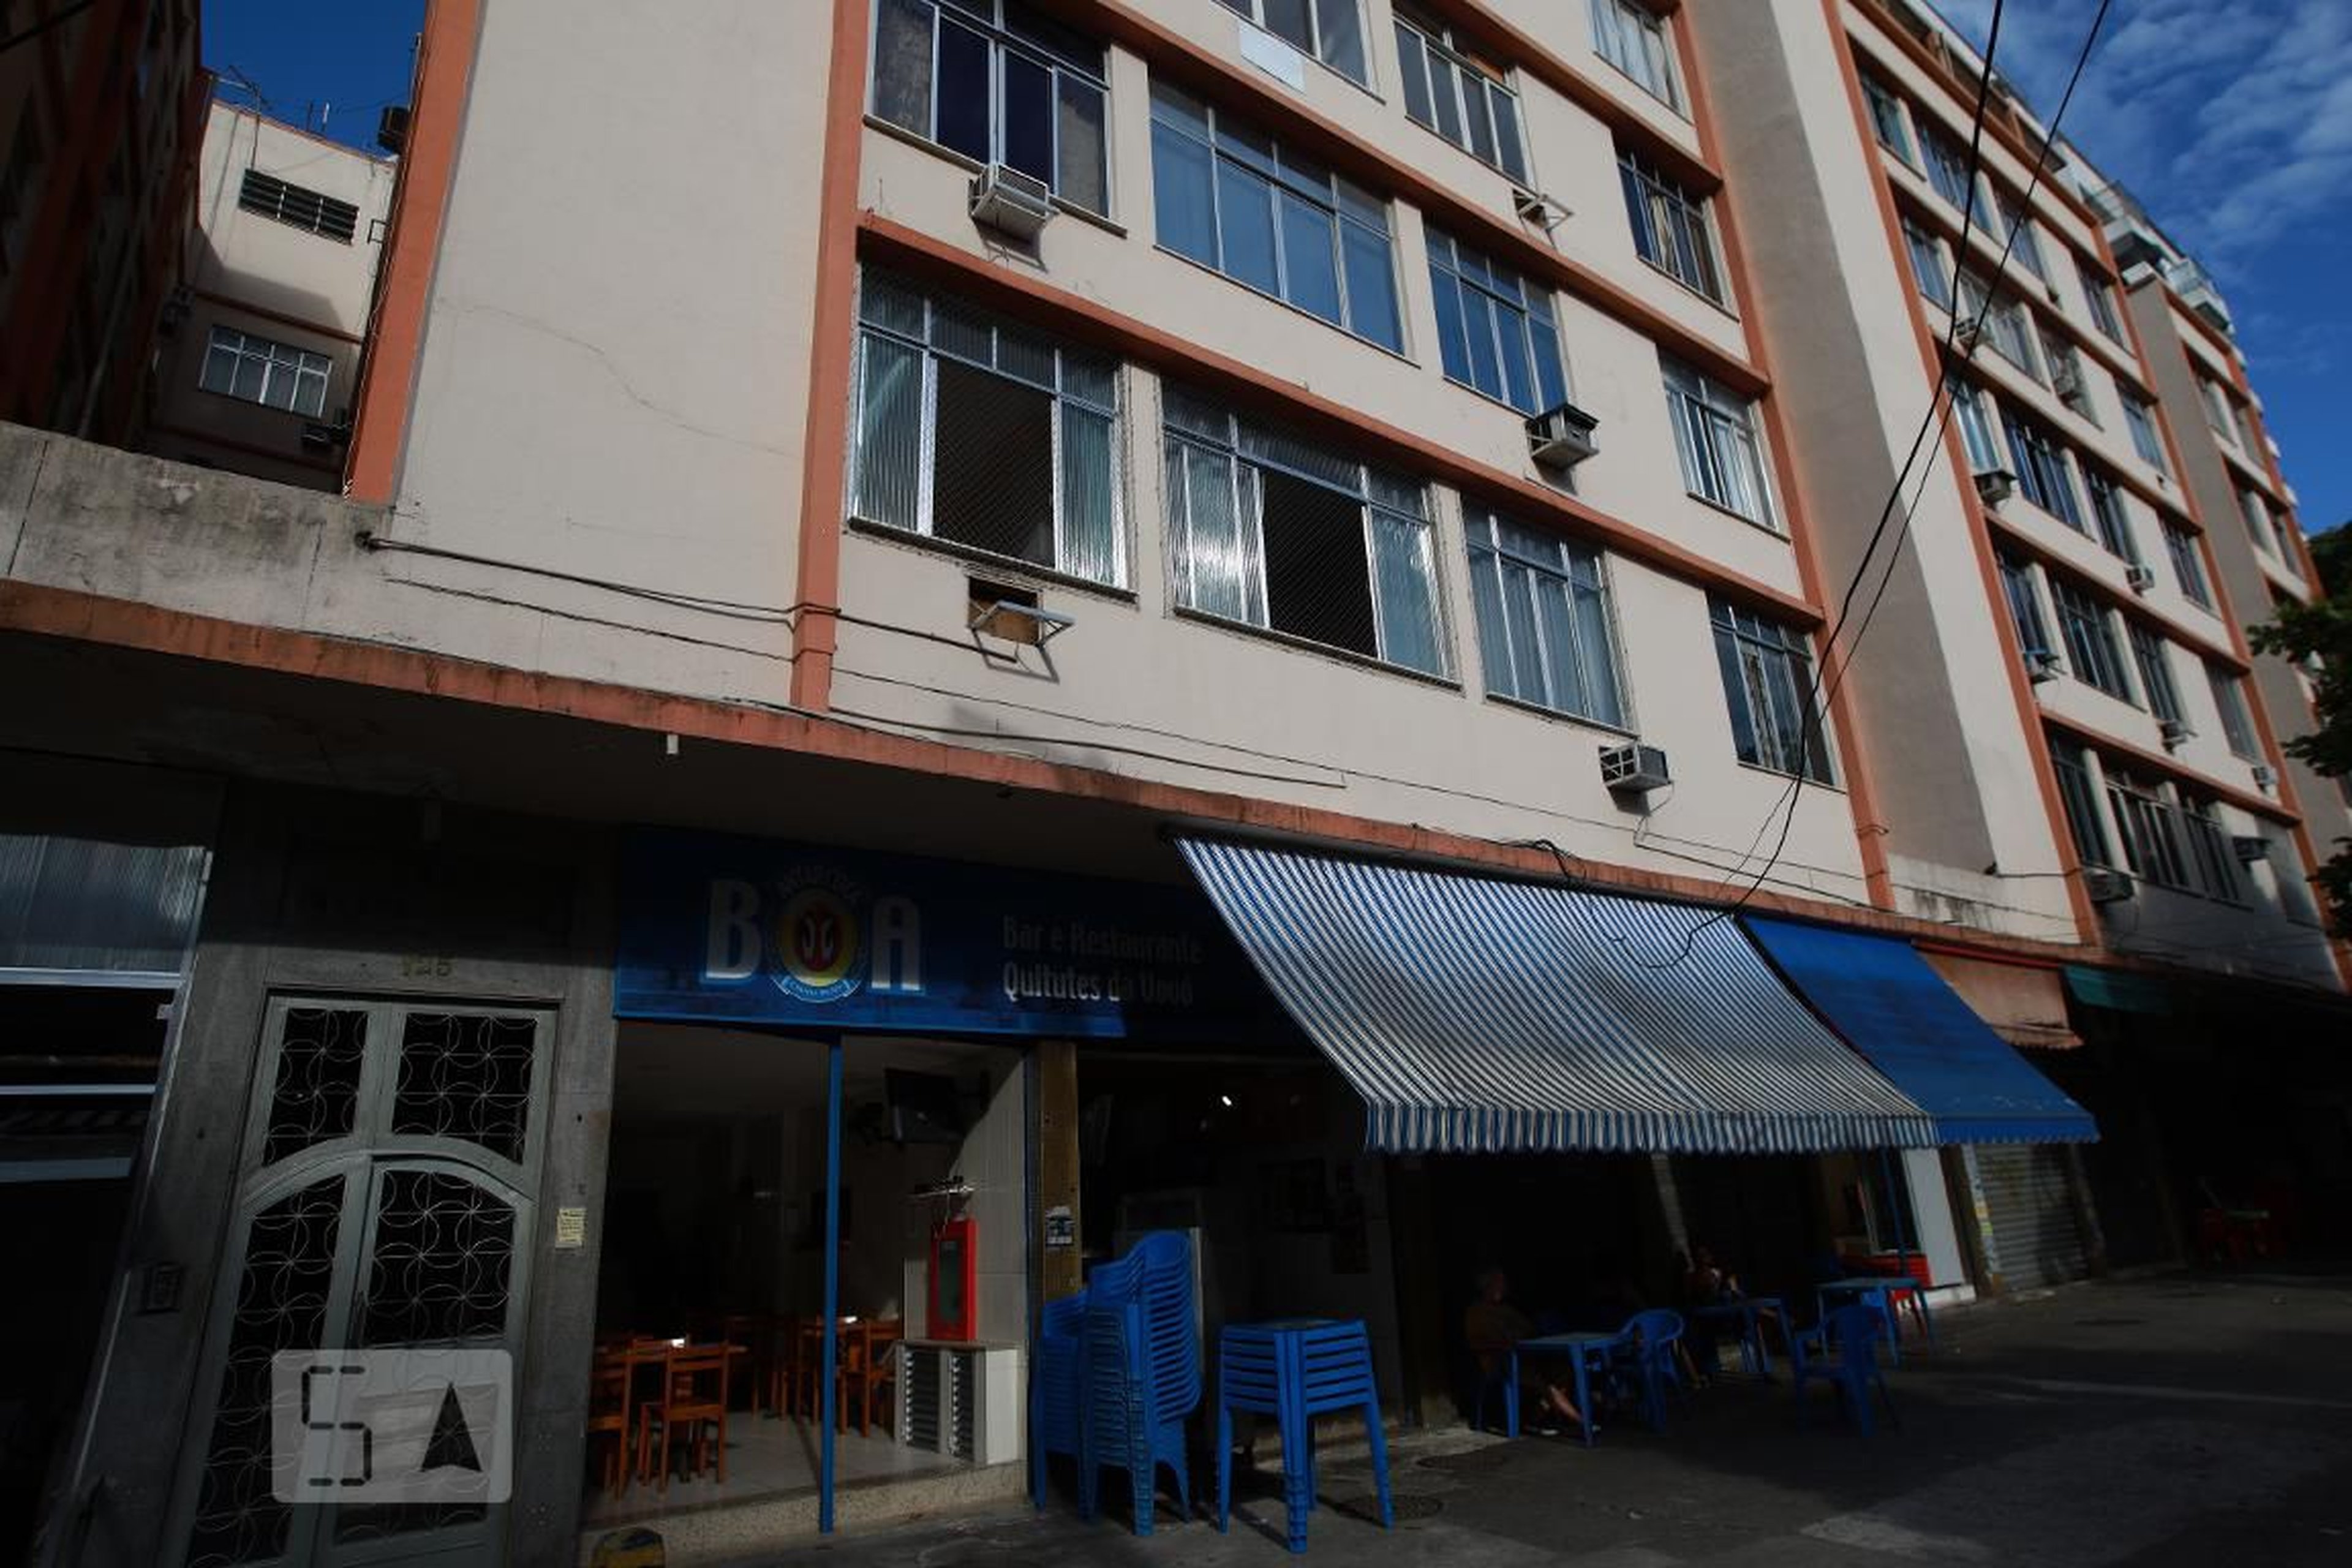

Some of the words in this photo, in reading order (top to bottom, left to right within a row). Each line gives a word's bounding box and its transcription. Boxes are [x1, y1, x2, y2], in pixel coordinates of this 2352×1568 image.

[1003, 914, 1043, 949] Bar
[1049, 924, 1065, 951] e
[1070, 918, 1205, 965] Restaurante
[1003, 961, 1102, 1003] Quitutes
